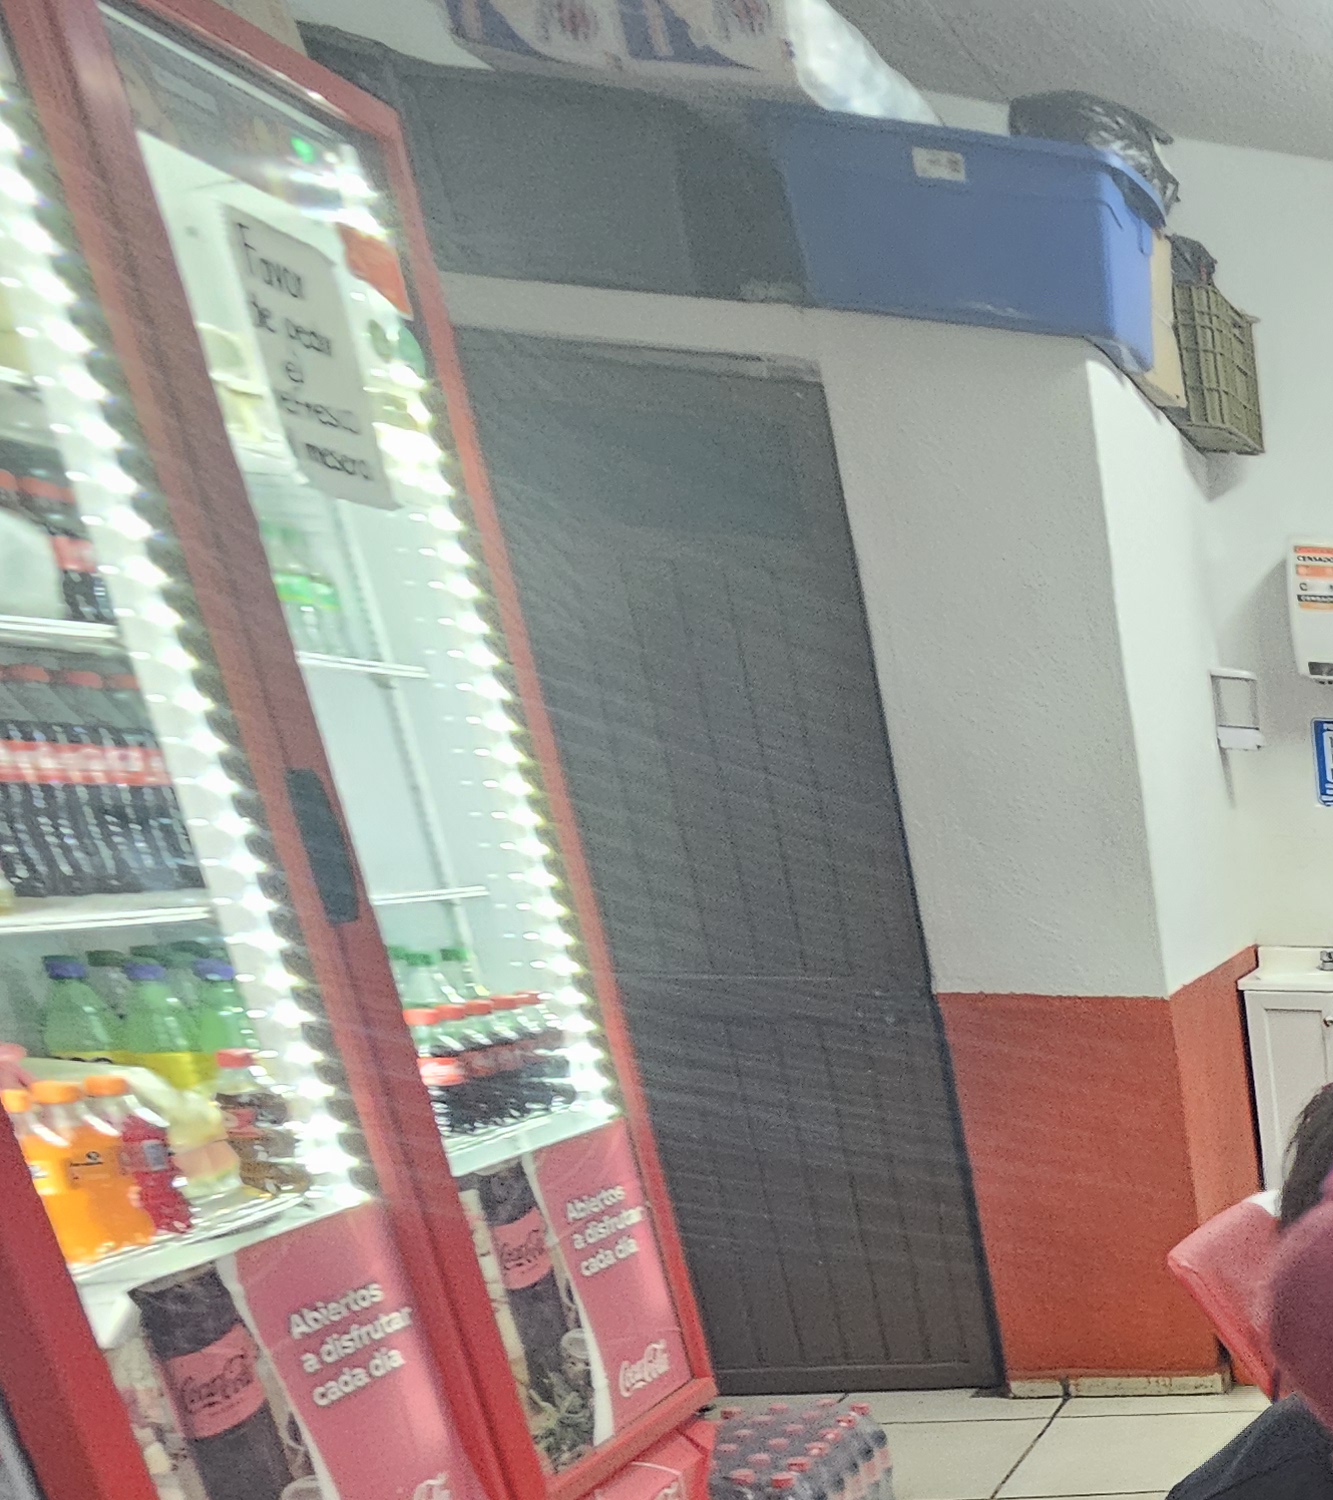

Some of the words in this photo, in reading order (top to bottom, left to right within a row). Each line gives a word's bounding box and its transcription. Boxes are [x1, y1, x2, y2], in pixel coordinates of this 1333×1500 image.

[290, 1283, 384, 1339] Abiertos
[302, 1353, 321, 1373] a
[320, 1306, 413, 1363] disfrutar
[313, 1367, 370, 1406] cada
